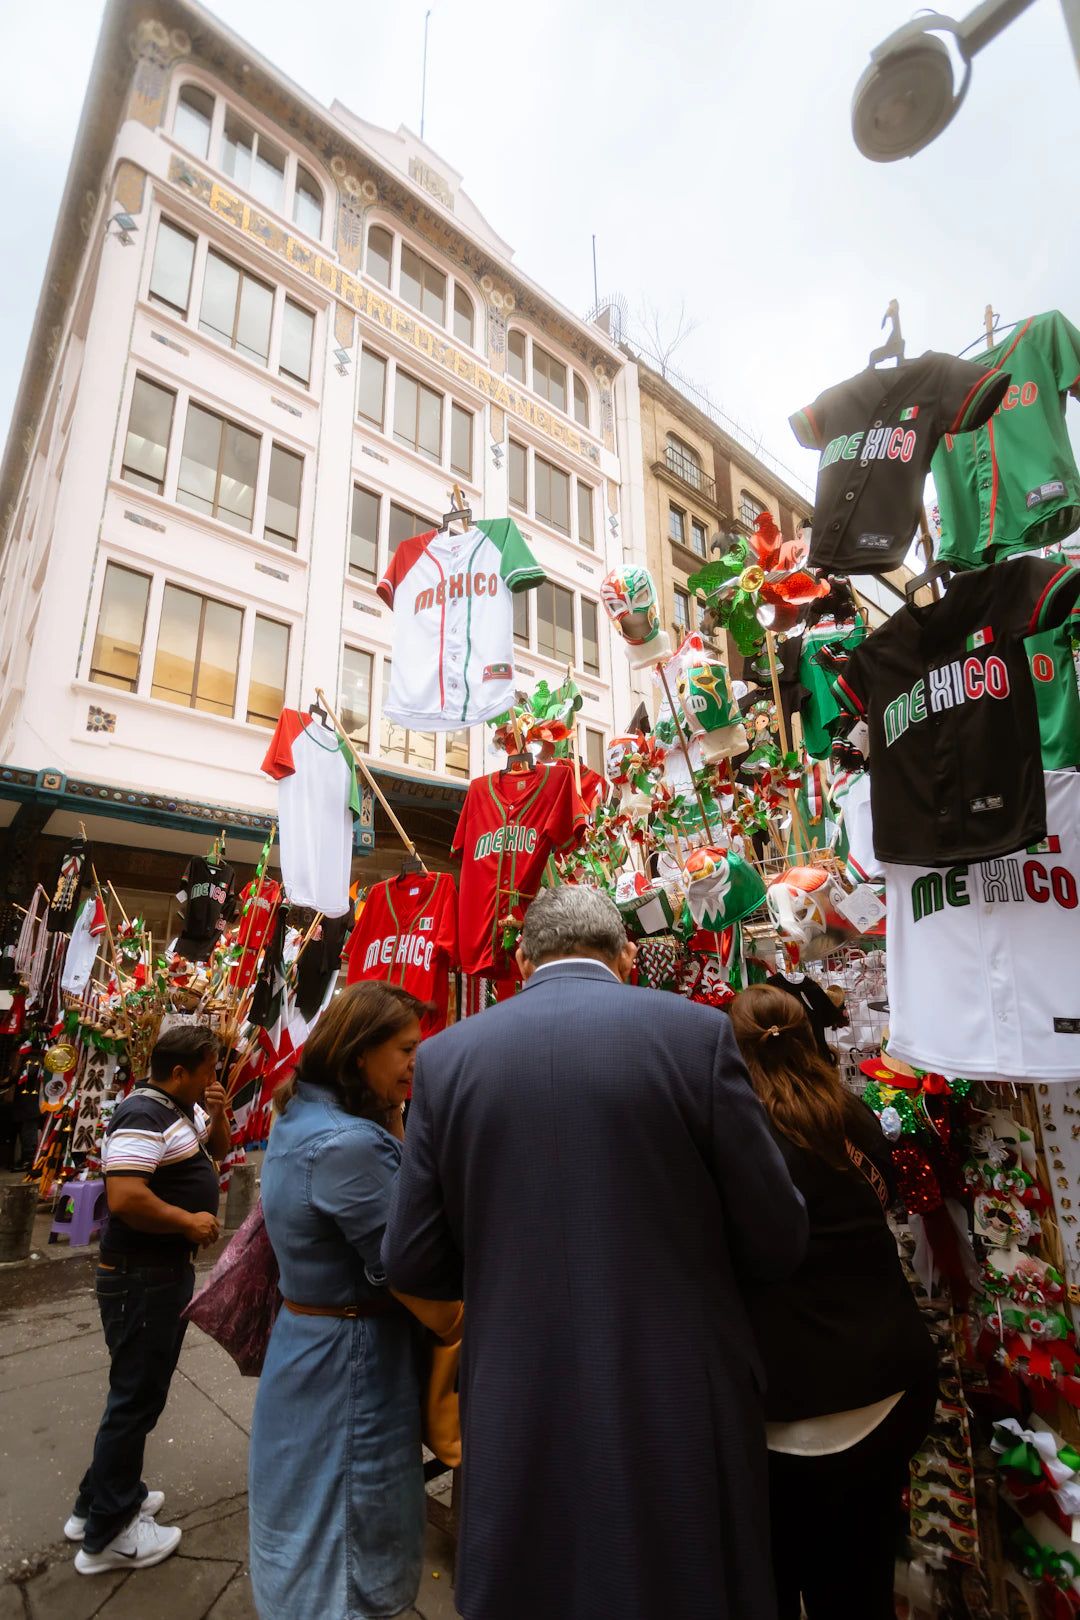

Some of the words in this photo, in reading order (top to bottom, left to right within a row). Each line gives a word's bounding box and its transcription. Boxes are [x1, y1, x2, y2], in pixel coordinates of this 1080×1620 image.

[209, 183, 265, 245] EL
[286, 236, 433, 356] CORREO
[454, 351, 581, 454] FRANCES
[818, 427, 916, 472] MEXICO
[414, 572, 498, 615] MEXICO
[883, 655, 1010, 748] MEXICO
[473, 825, 538, 861] MEXIC
[911, 858, 1078, 923] MEXICO
[362, 935, 434, 973] MEXICO
